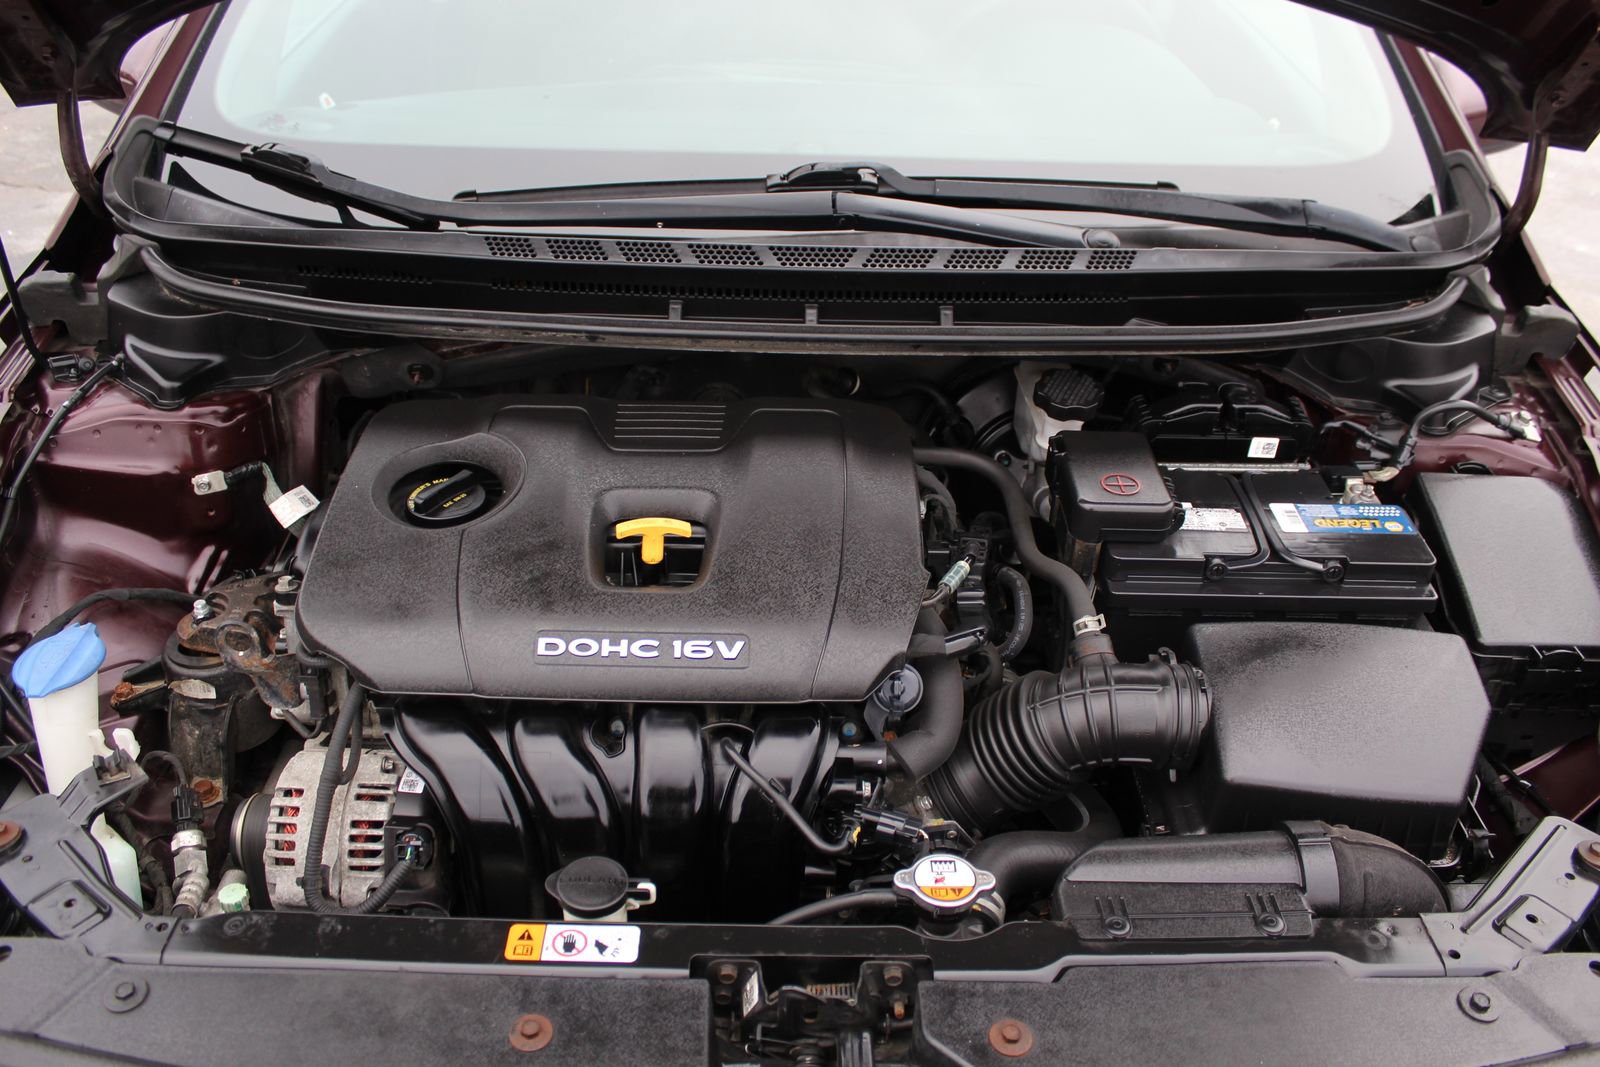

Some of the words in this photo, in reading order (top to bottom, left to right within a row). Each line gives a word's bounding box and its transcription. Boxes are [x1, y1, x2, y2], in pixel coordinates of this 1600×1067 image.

[1313, 518, 1380, 528] LEGEND
[536, 637, 661, 659] DOHC
[672, 639, 746, 660] 16V
